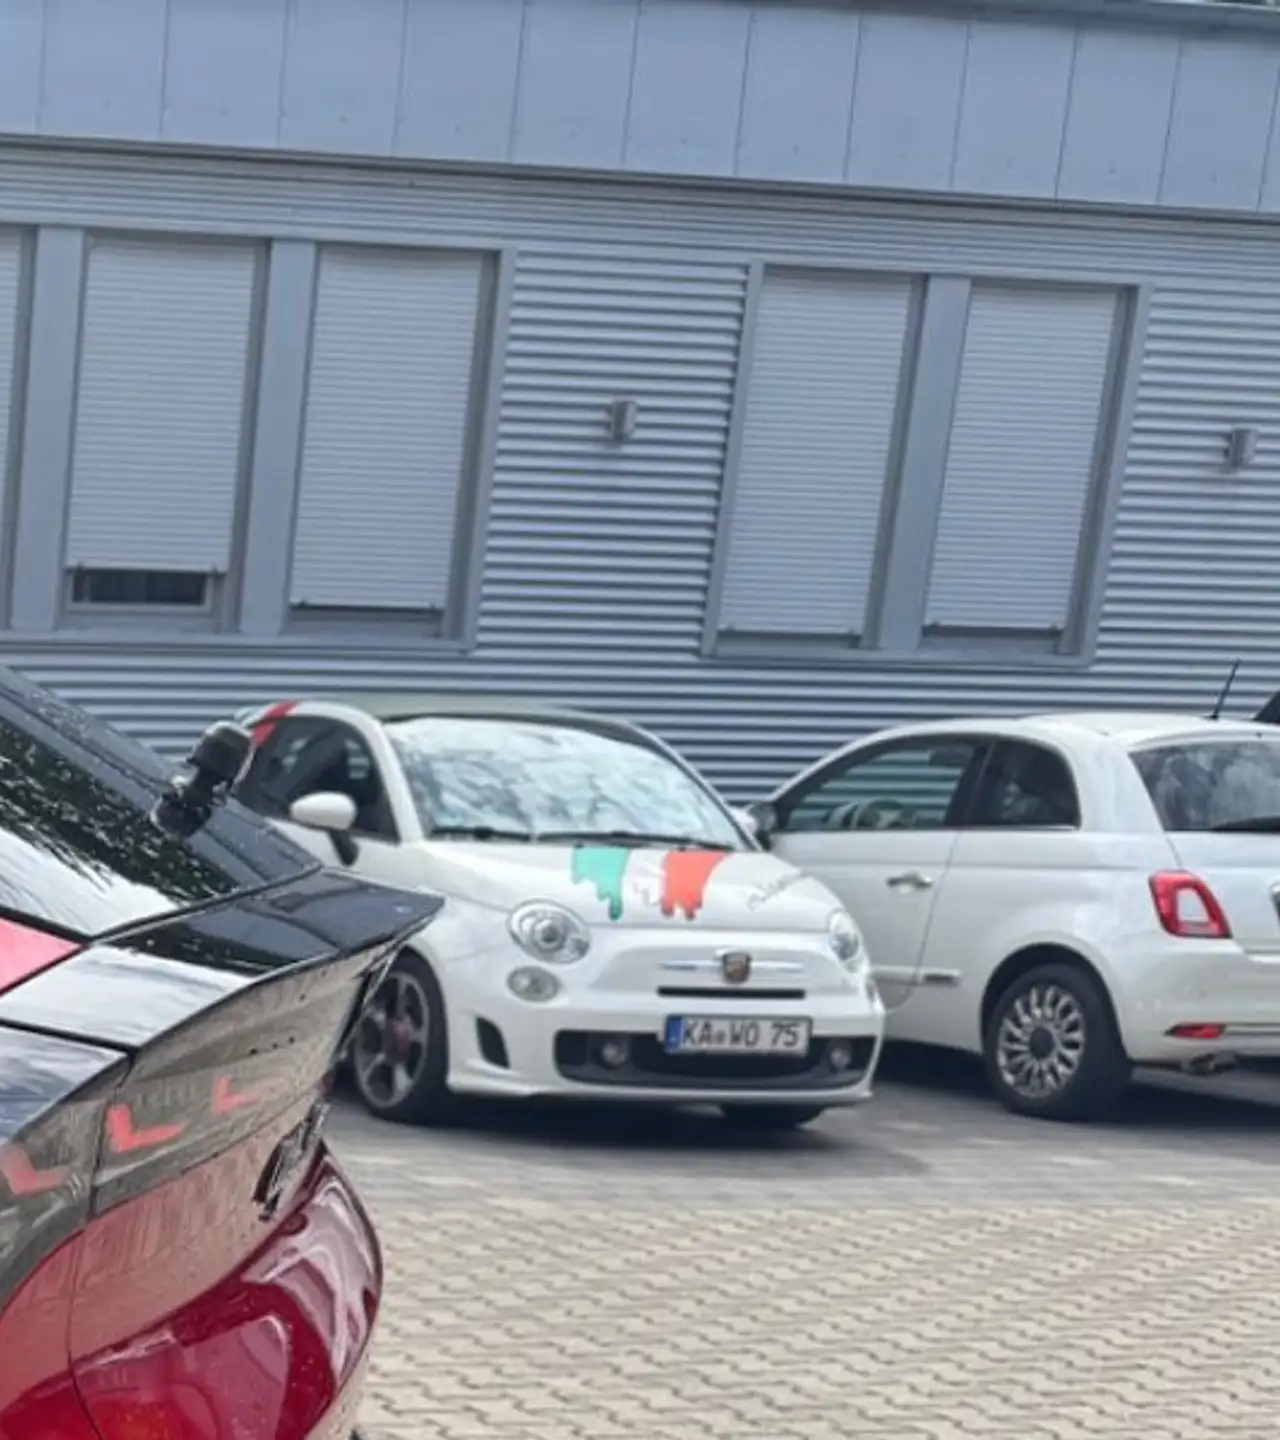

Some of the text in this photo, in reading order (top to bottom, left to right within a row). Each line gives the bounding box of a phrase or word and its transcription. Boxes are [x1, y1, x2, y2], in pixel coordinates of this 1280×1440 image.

[683, 1020, 800, 1048] KA WO 75
